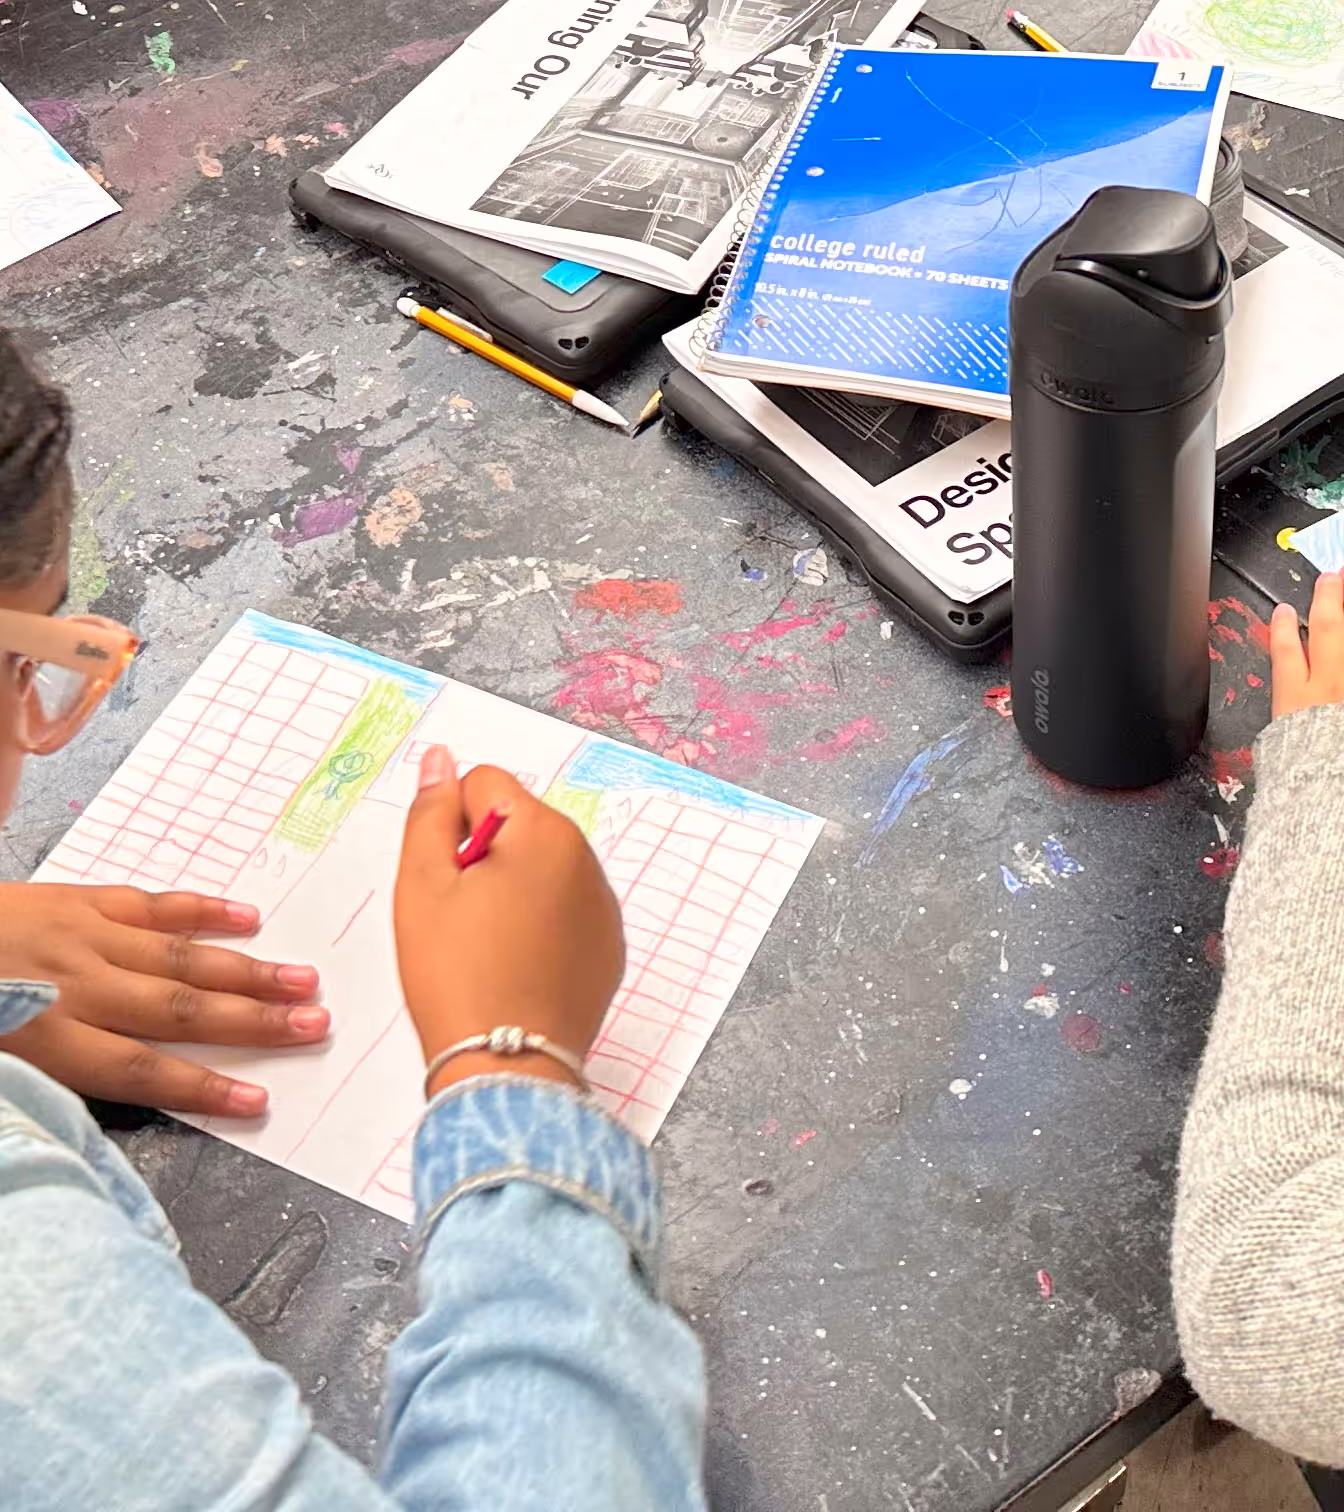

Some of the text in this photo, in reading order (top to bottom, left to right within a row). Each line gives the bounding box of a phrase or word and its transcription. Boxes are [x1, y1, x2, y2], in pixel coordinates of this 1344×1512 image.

[511, 54, 570, 100] Our
[764, 251, 1009, 291] SPIRAL NOTEBOOK 70 SHEETS
[770, 233, 926, 264] college ruled
[898, 453, 1012, 529] Desi
[946, 514, 1014, 565] Sp
[1030, 669, 1049, 734] owala
